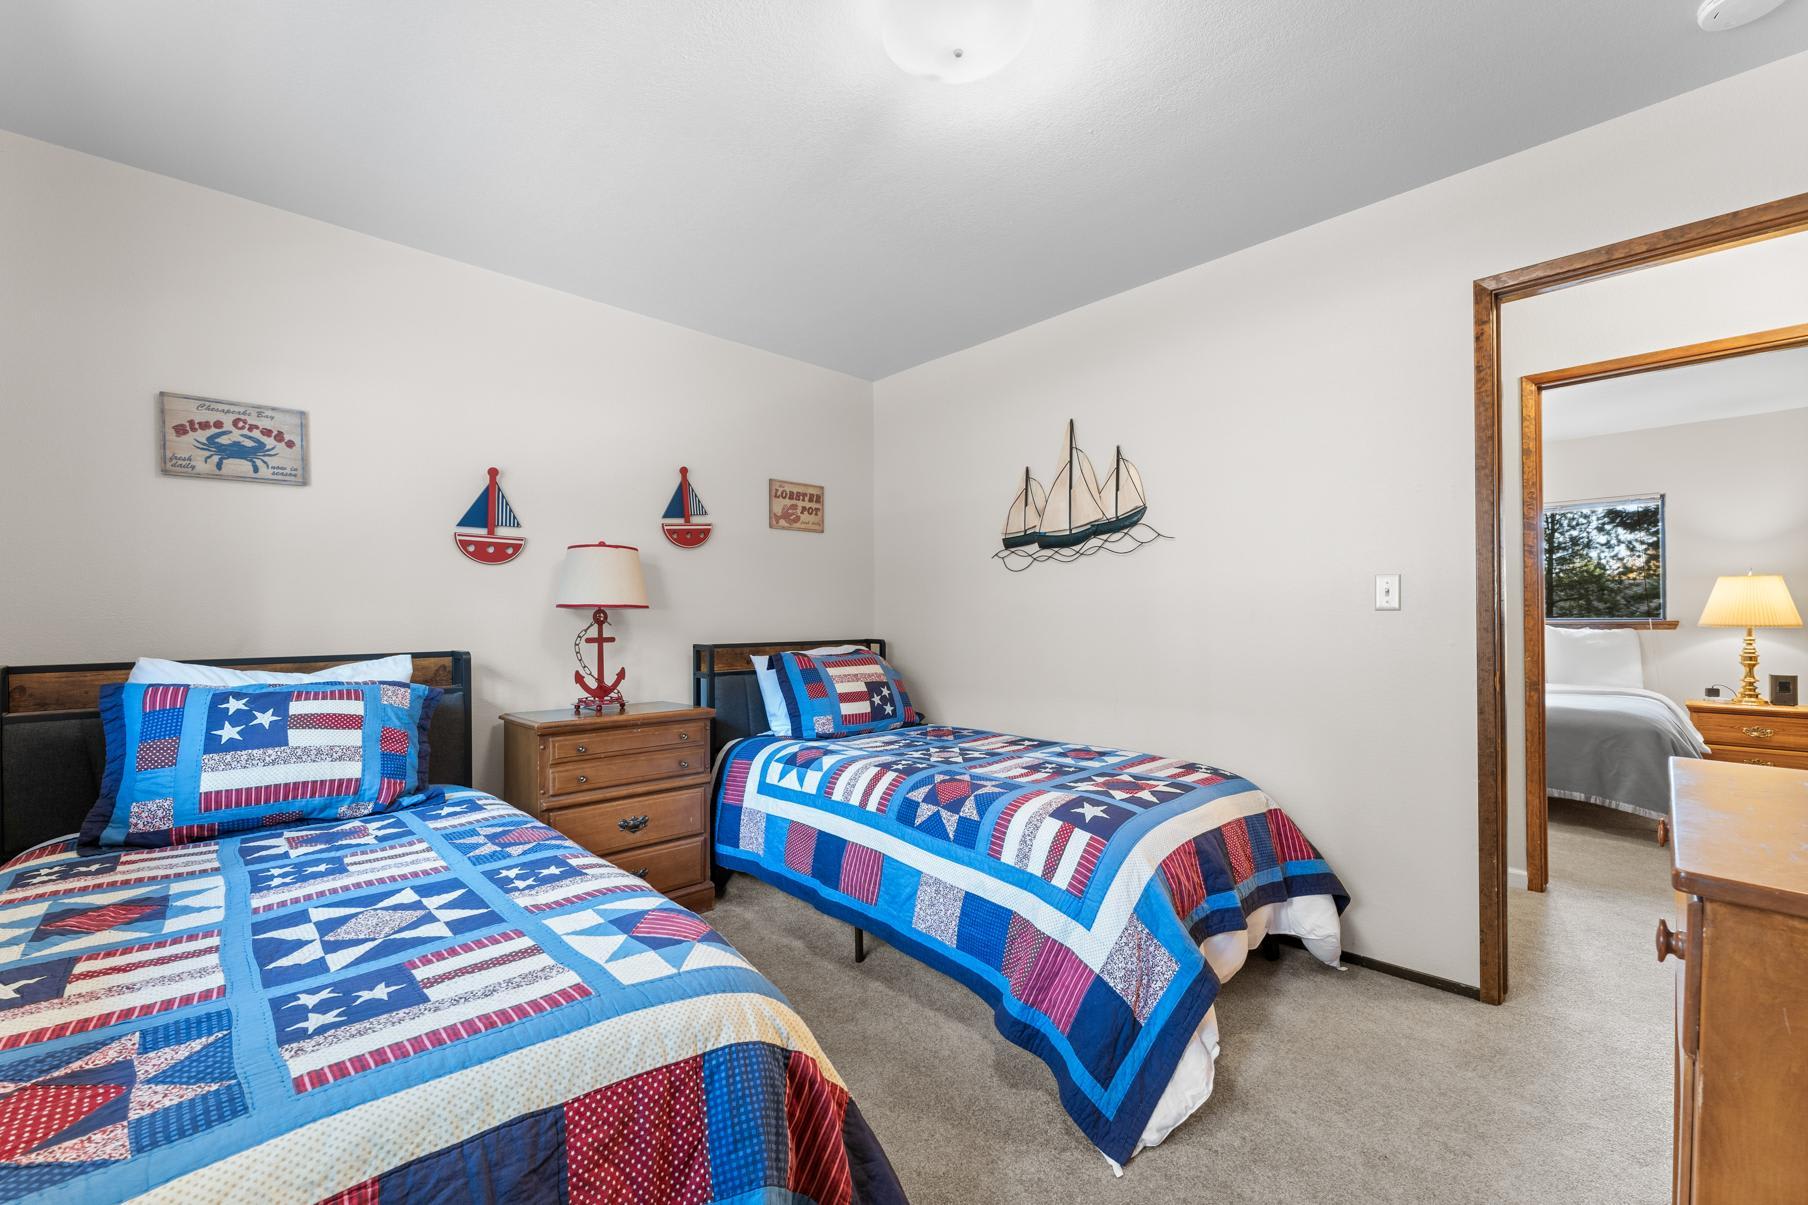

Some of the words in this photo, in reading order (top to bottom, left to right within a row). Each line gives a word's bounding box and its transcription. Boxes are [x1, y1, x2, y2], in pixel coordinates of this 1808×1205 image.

[172, 419, 224, 437] Blue
[232, 417, 296, 449] Crabs
[171, 461, 196, 471] daily
[774, 488, 822, 504] LOBSTER
[800, 506, 821, 516] POT
